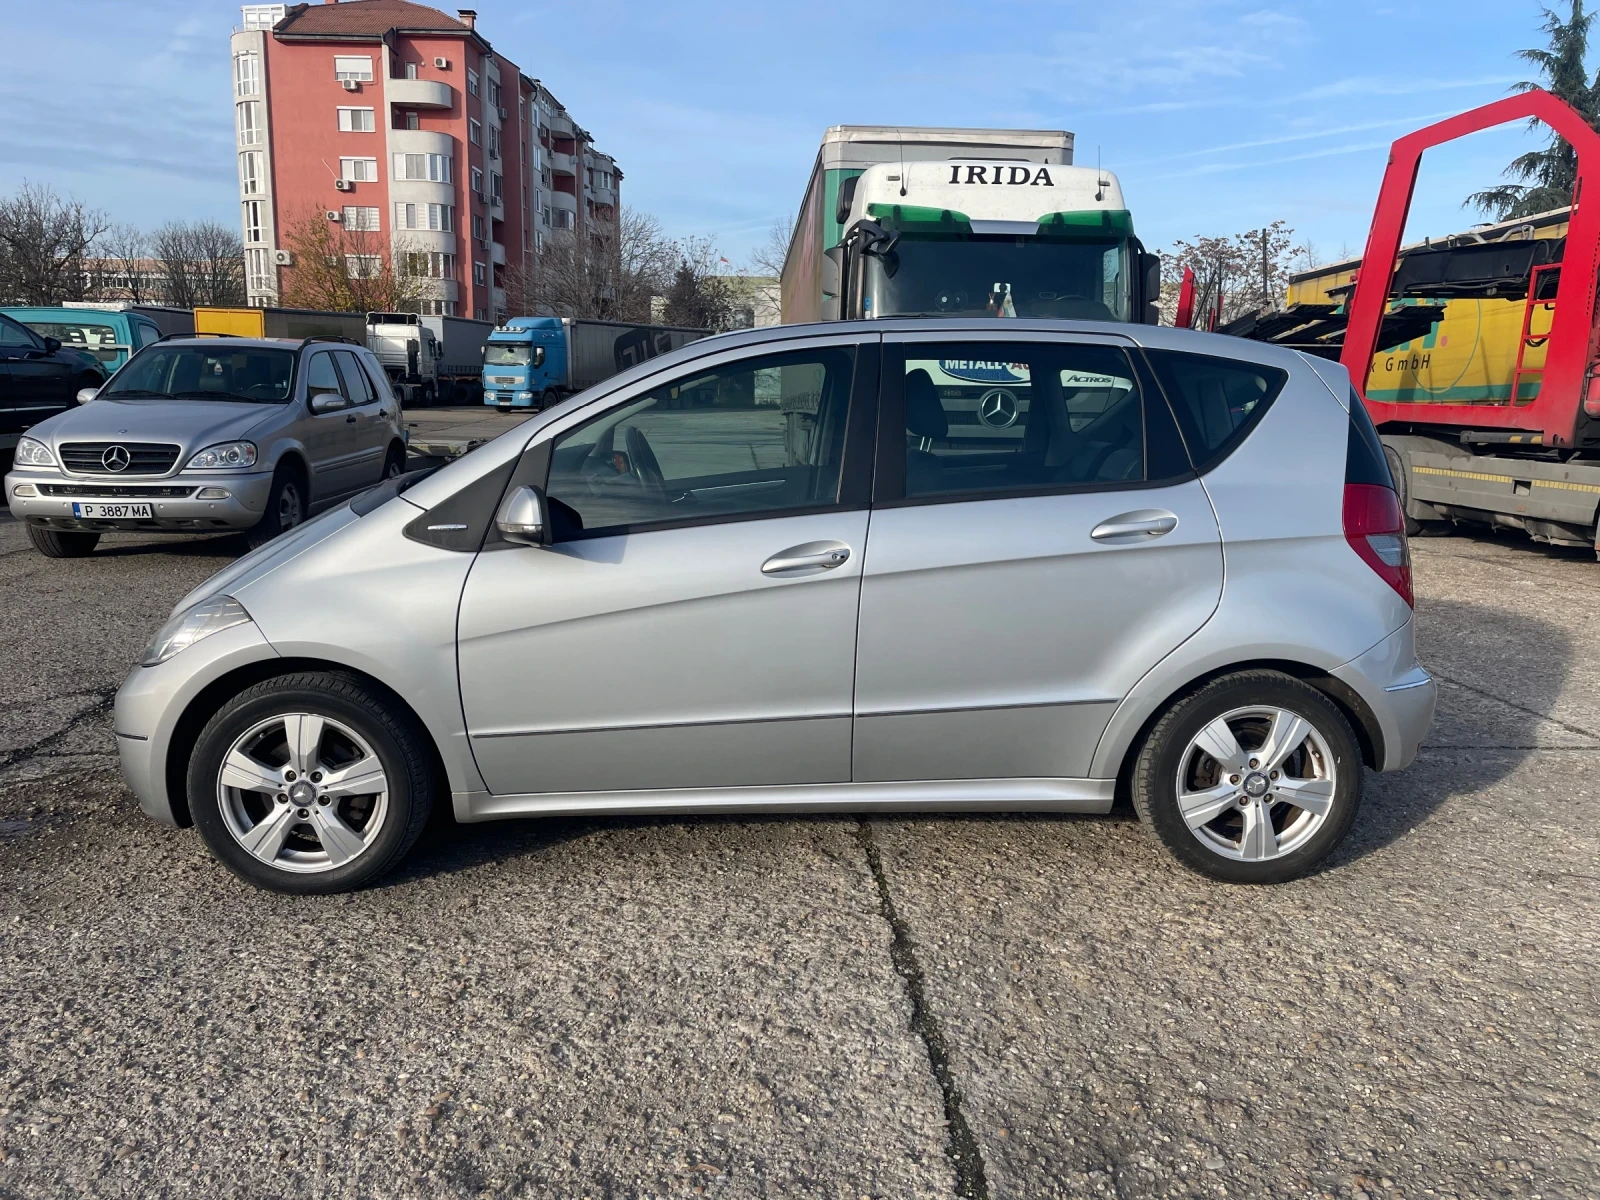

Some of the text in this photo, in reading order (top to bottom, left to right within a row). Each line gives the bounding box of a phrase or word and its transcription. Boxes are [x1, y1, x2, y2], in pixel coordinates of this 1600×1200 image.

[948, 165, 1054, 187] IRIDA
[1385, 353, 1431, 372] GmbH
[84, 506, 150, 516] P 3887 MA
